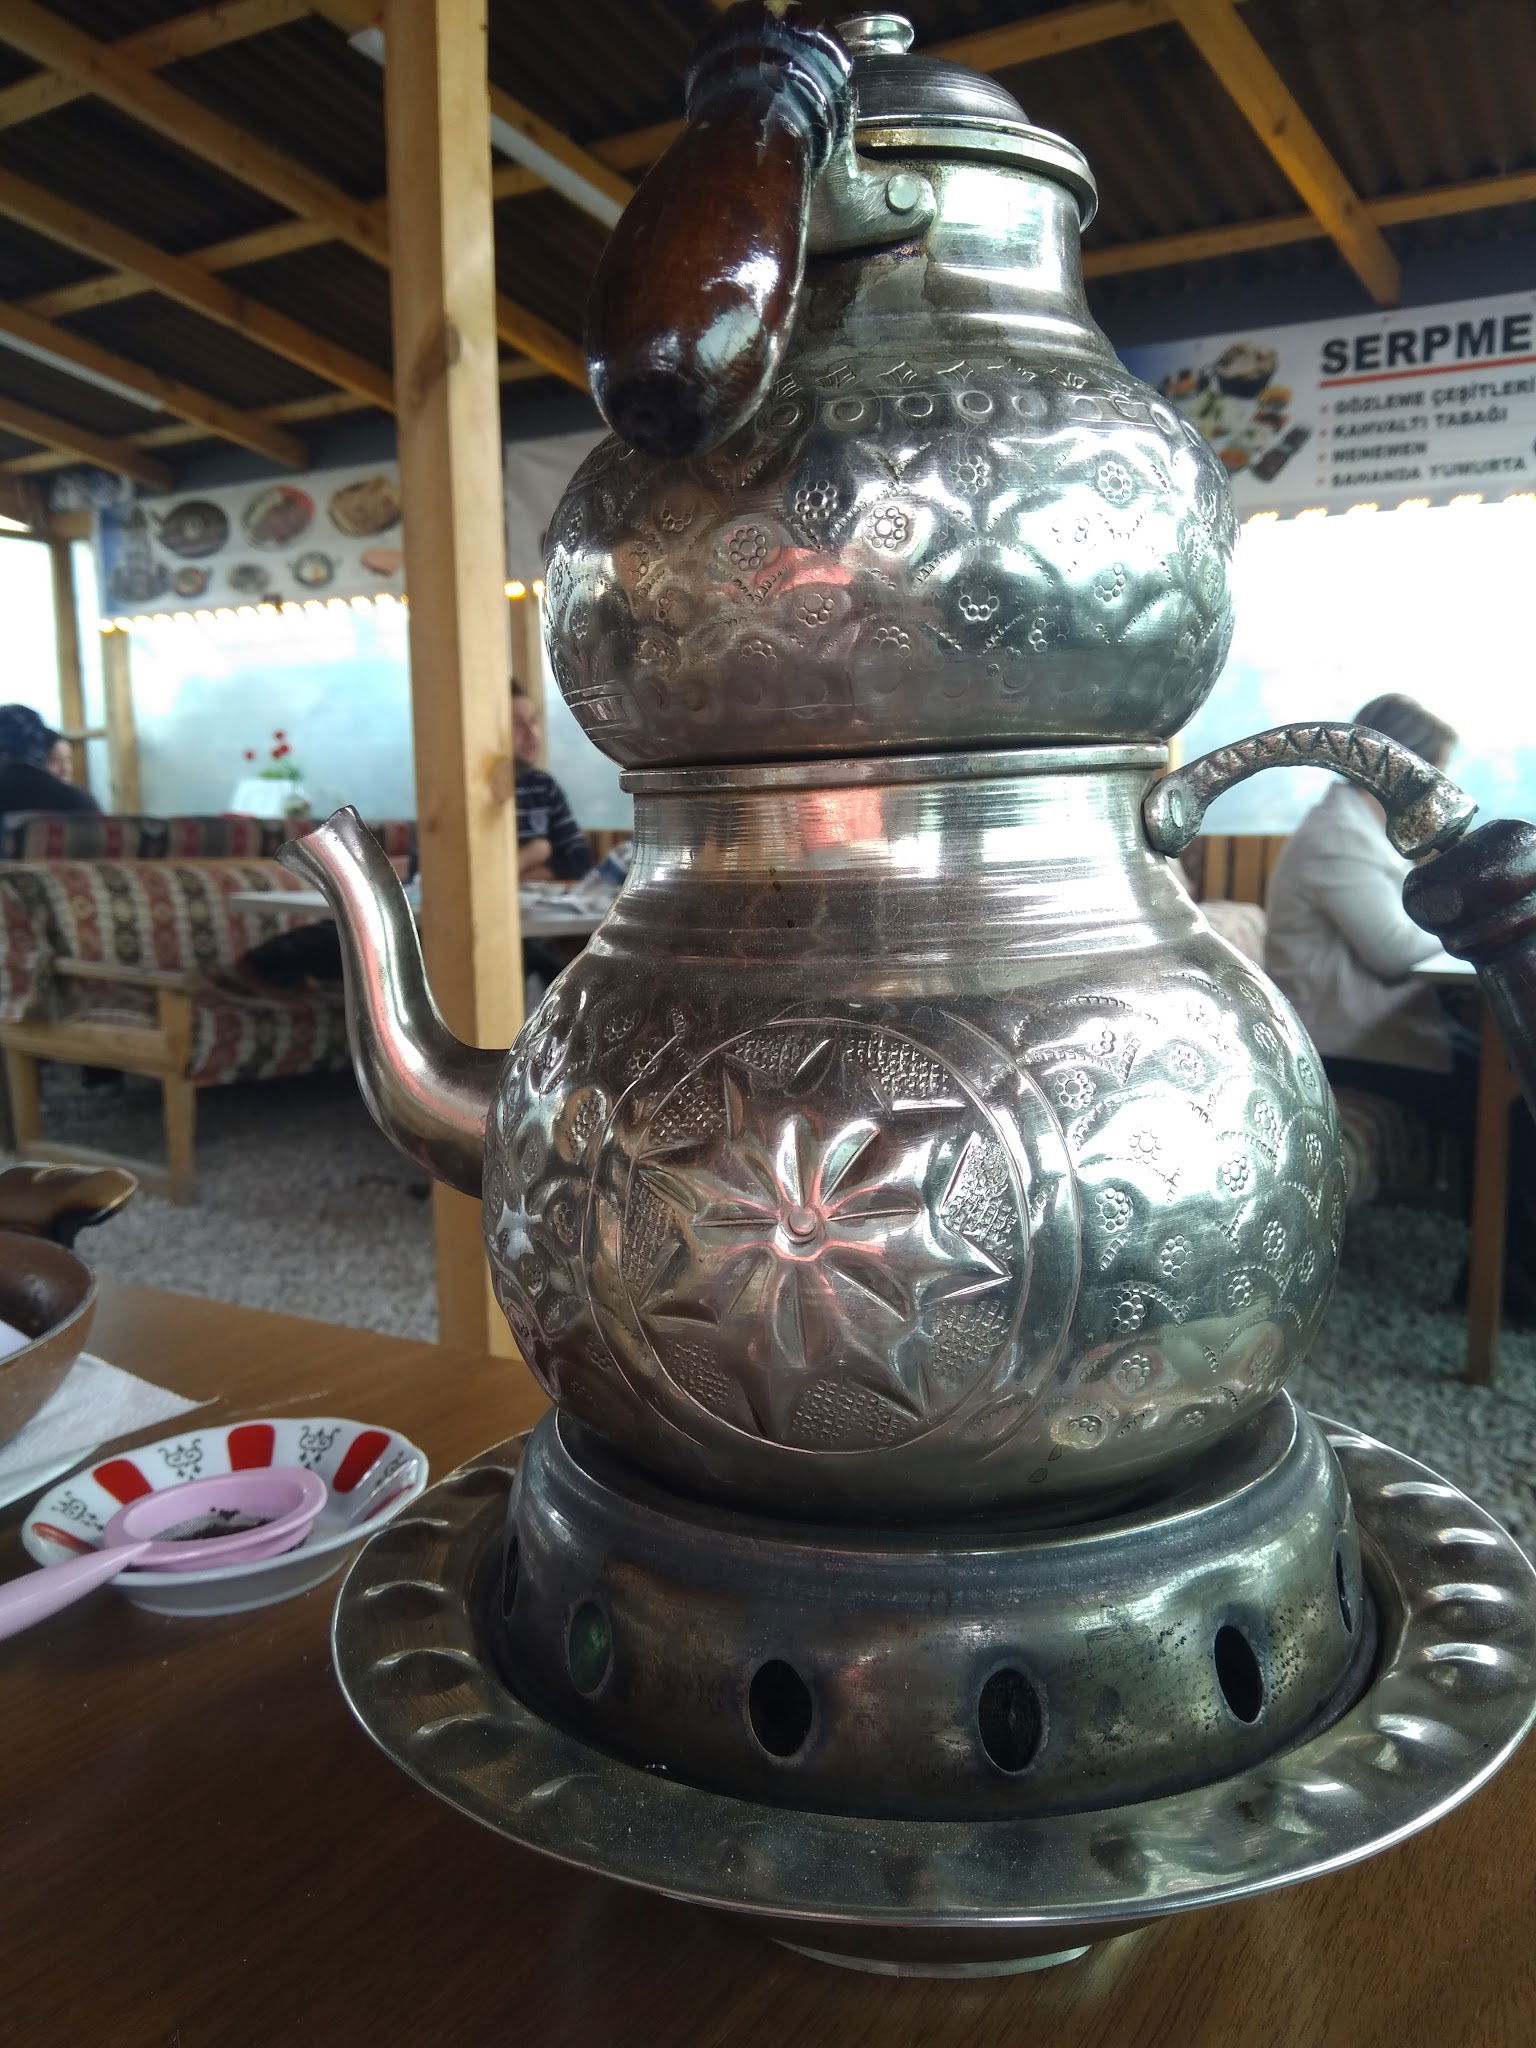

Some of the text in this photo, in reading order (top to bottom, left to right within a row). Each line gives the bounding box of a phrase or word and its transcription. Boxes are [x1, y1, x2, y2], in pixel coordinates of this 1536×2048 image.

[1321, 312, 1534, 375] SERPME
[1334, 390, 1425, 415] GÖZLEME
[1333, 405, 1508, 438] KAHVALTI TABAĞI
[1332, 440, 1428, 463] MENEMEN
[1331, 457, 1526, 487] SAHANDA YUMURTA
